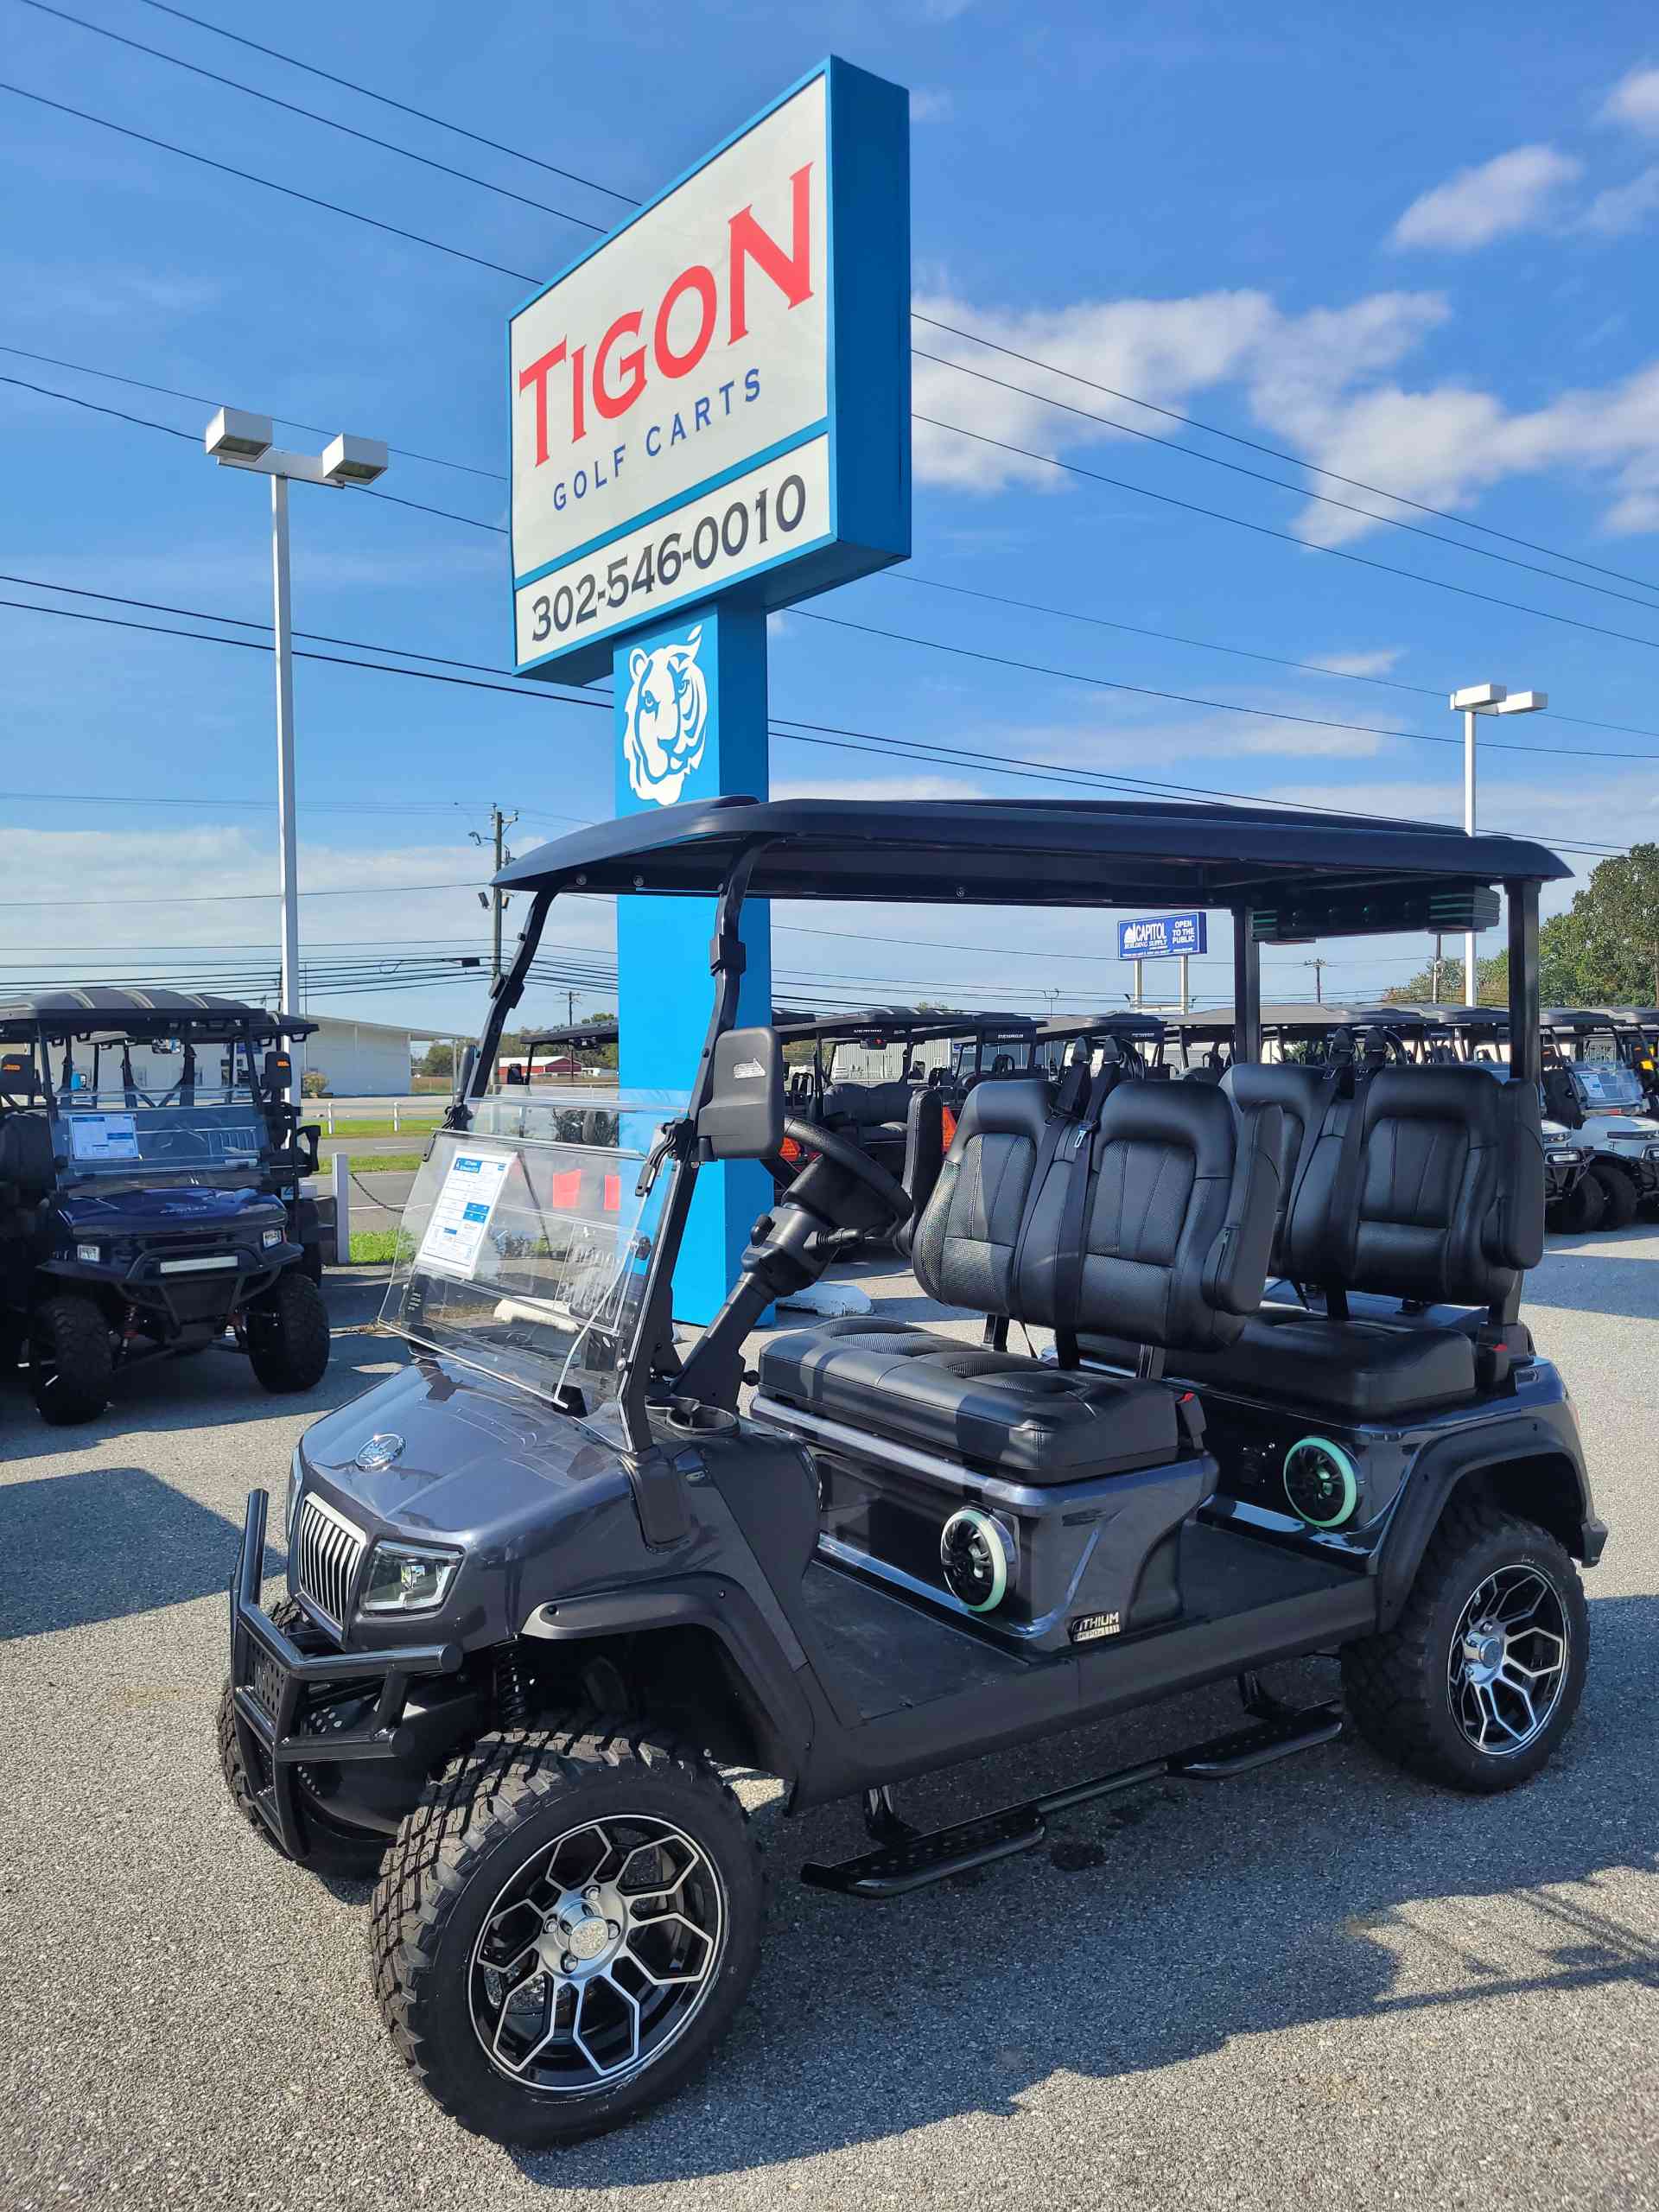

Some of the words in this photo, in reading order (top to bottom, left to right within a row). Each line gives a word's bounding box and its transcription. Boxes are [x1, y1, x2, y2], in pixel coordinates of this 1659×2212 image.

[518, 162, 814, 467] TIGON
[553, 444, 626, 512] GOLF
[645, 368, 761, 457] CARTS
[531, 474, 806, 641] 302-546-0010
[1135, 923, 1167, 941] CAPITOL
[1173, 935, 1195, 944] PUBLIC
[1175, 919, 1192, 929] OPEN
